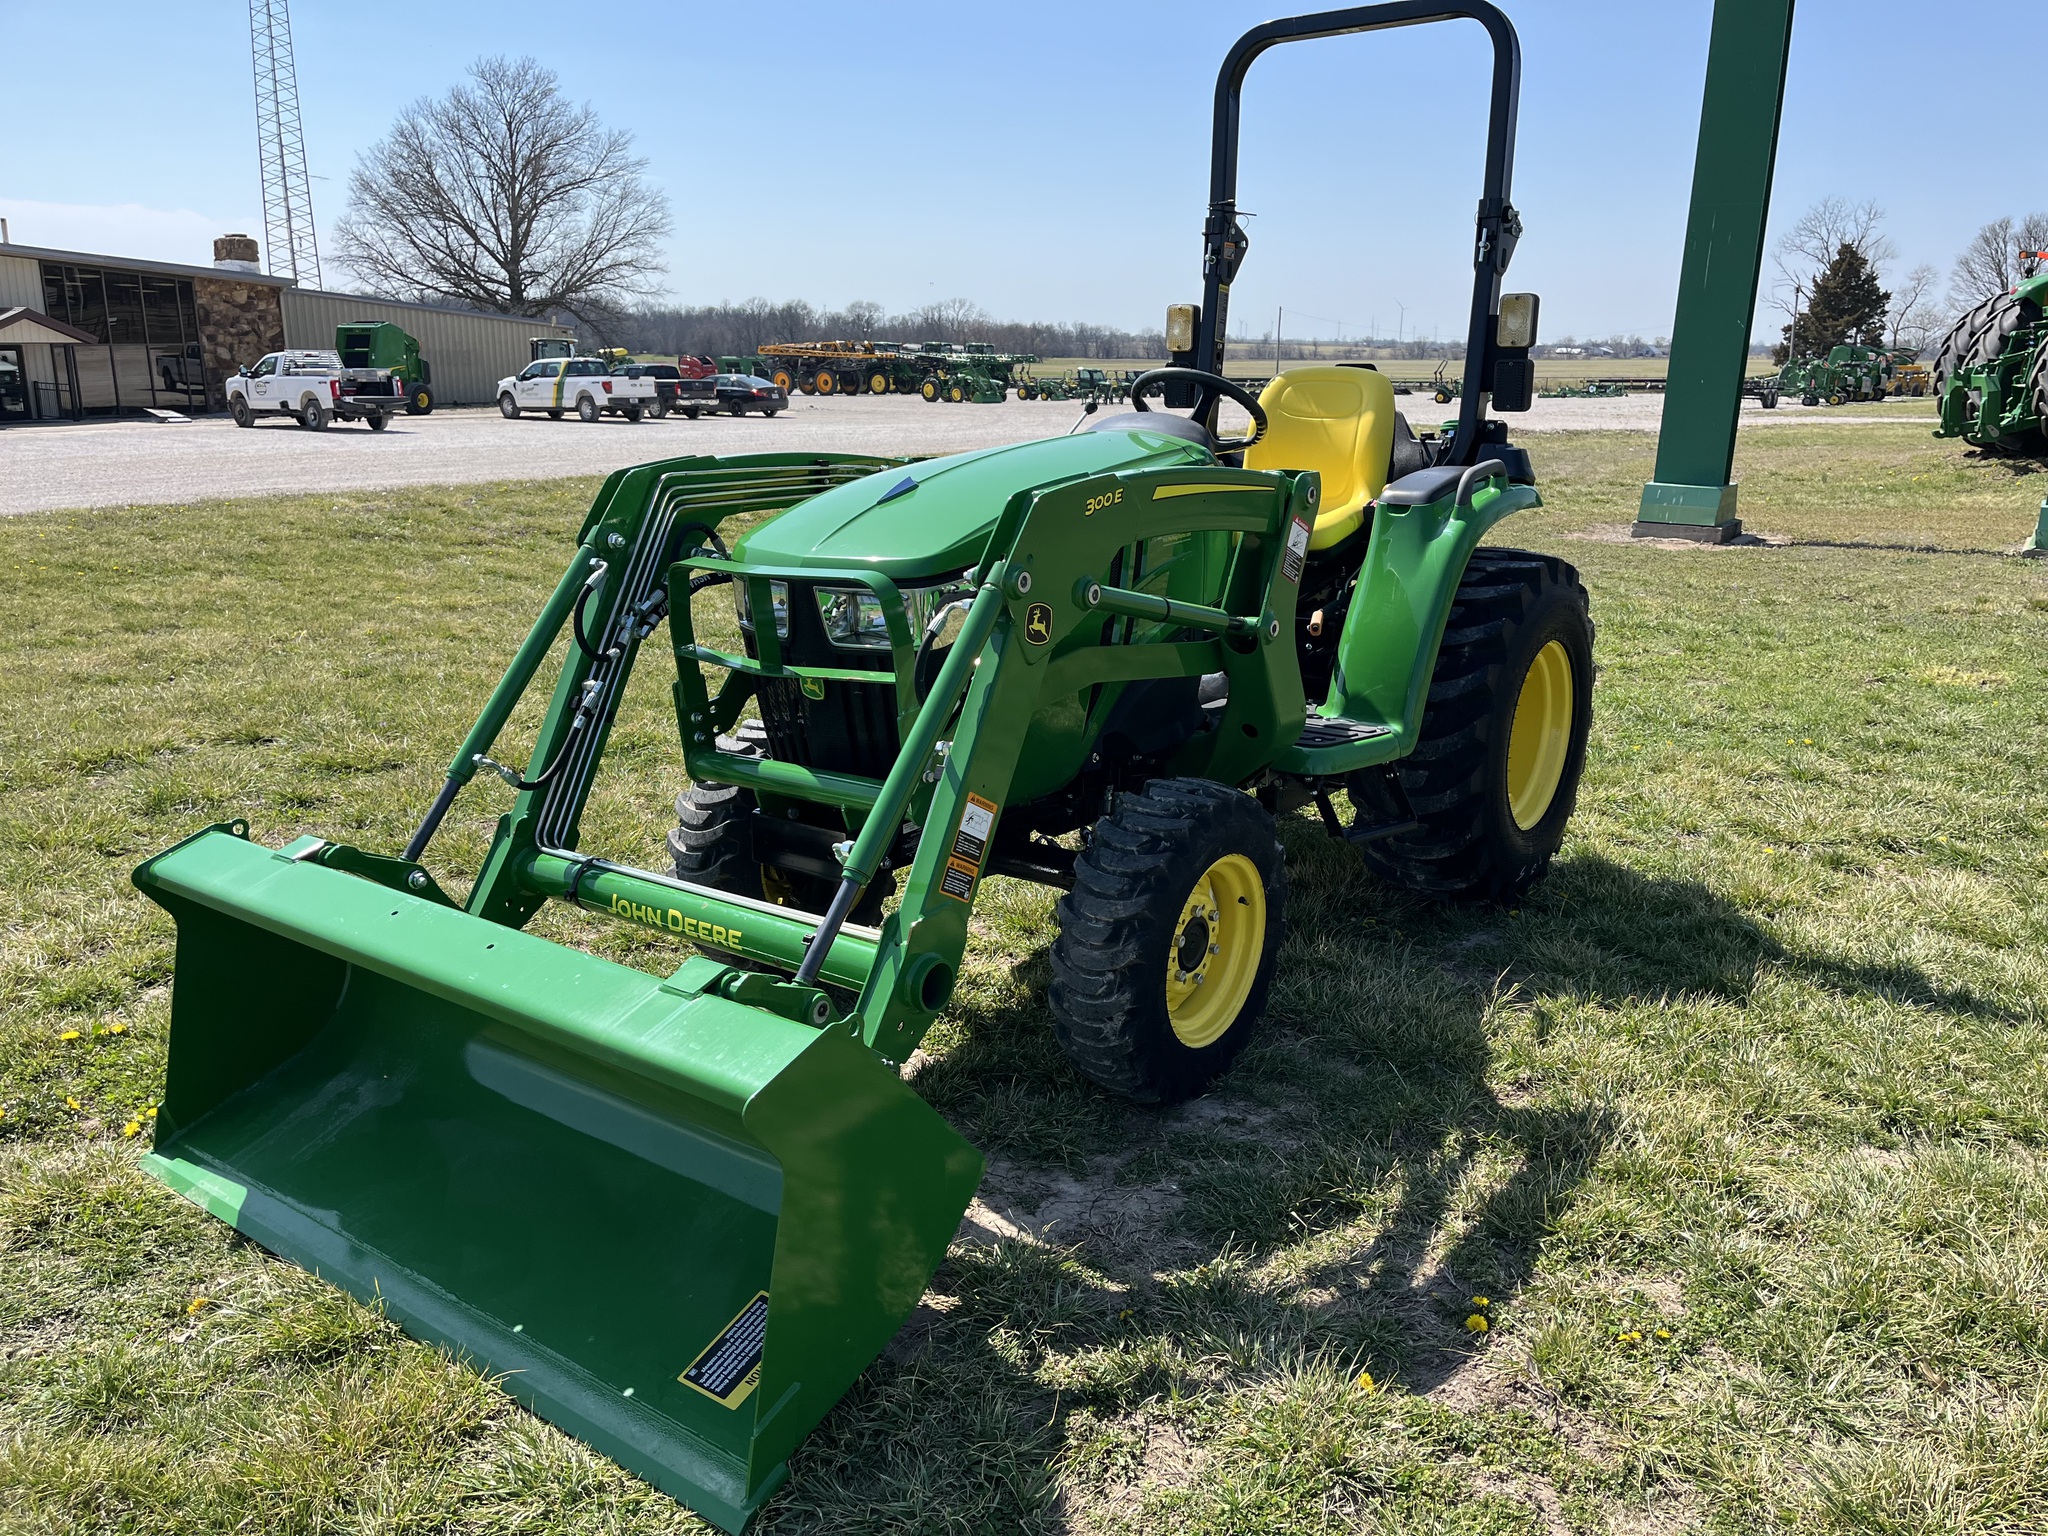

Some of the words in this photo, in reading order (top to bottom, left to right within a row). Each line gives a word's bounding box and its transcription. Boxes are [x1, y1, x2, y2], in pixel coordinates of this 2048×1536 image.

[975, 798, 993, 811] WARNING
[956, 862, 975, 875] WARNING
[607, 892, 663, 928] JOHN
[667, 908, 743, 951] DEERE
[745, 1367, 761, 1386] ION
